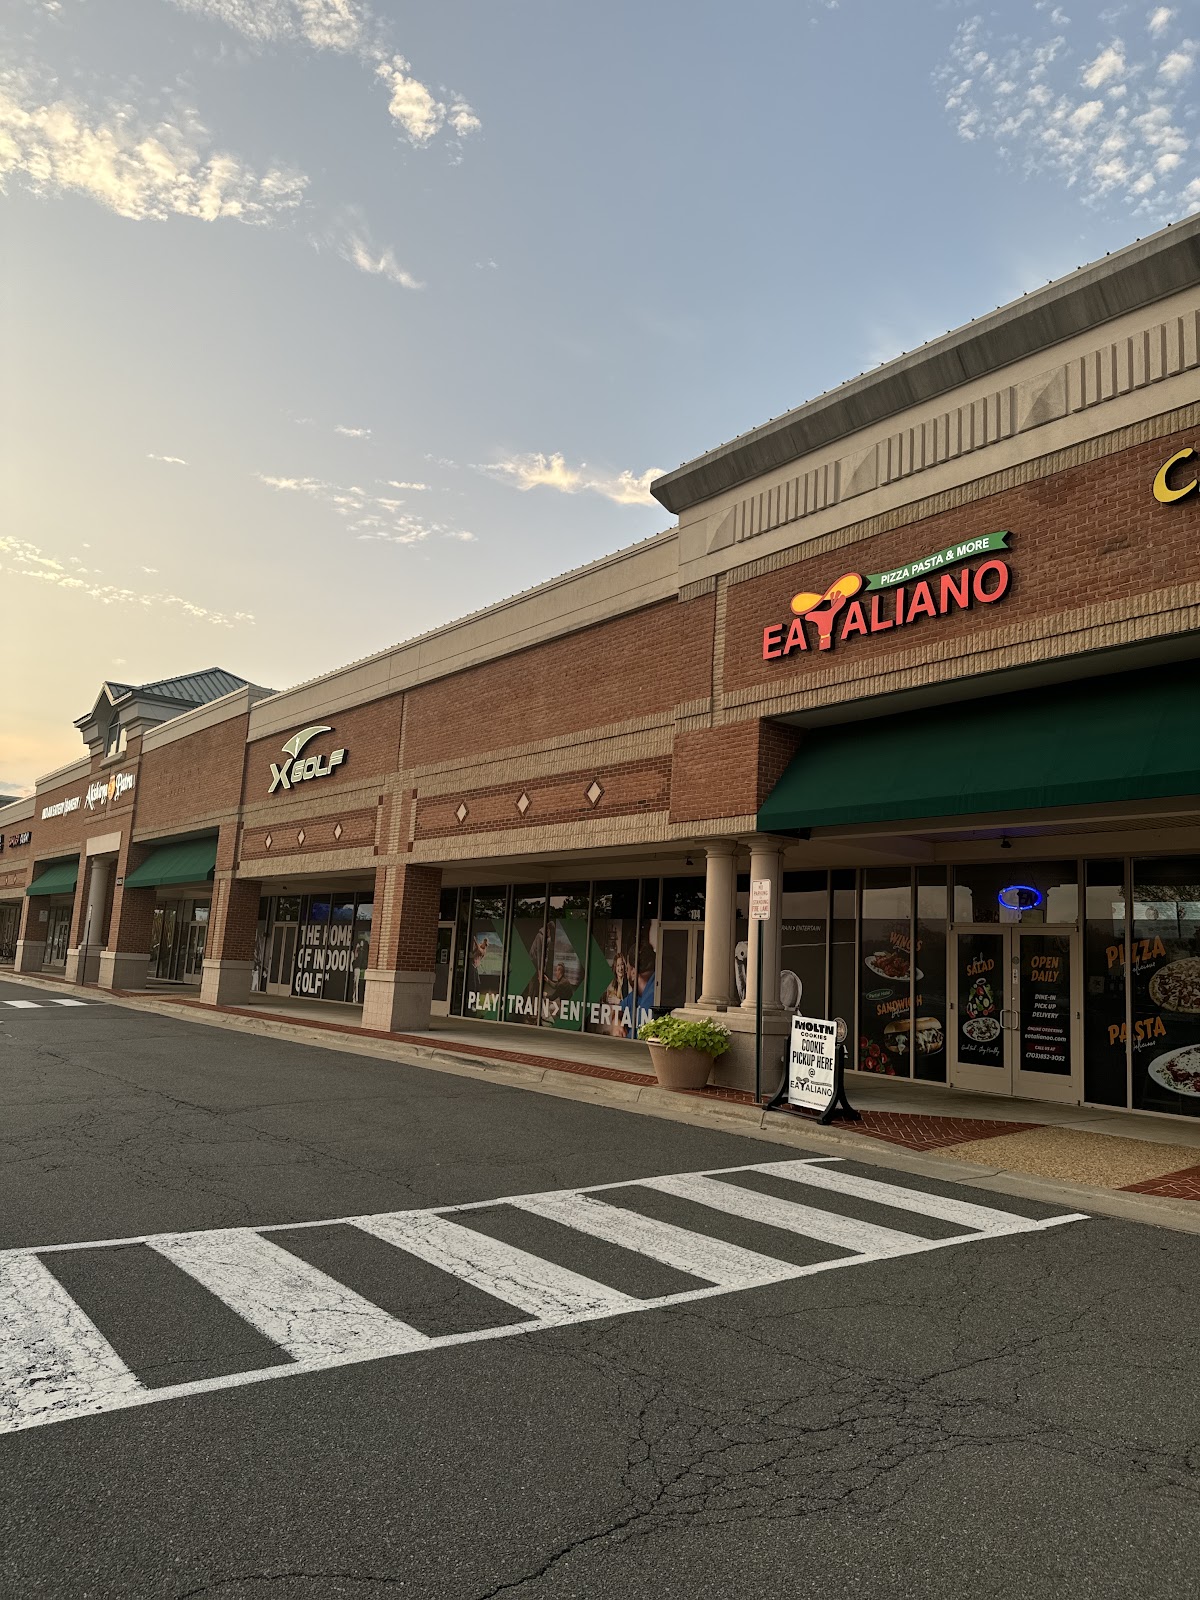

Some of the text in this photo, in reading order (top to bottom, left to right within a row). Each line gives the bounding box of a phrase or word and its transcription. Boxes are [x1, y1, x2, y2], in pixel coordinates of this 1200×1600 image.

[880, 537, 990, 586] PIZZA PASTA & MORE
[301, 925, 322, 946] THE
[1105, 934, 1167, 969] PIZZA
[966, 958, 995, 977] SALAD
[1031, 955, 1060, 969] OPEN
[1031, 969, 1060, 983] DAILY
[468, 991, 500, 1012] PLAY
[508, 994, 549, 1017] TRAIN
[1034, 993, 1057, 1001] DINE-IN
[1032, 1011, 1060, 1019] DELIVERY
[794, 1020, 835, 1035] MOLTN
[800, 1031, 828, 1041] COOKIES
[1108, 1016, 1167, 1046] PASTA
[801, 1038, 825, 1055] COOKIE
[792, 1050, 834, 1071] PICKUP HERE
[808, 1068, 816, 1078] @
